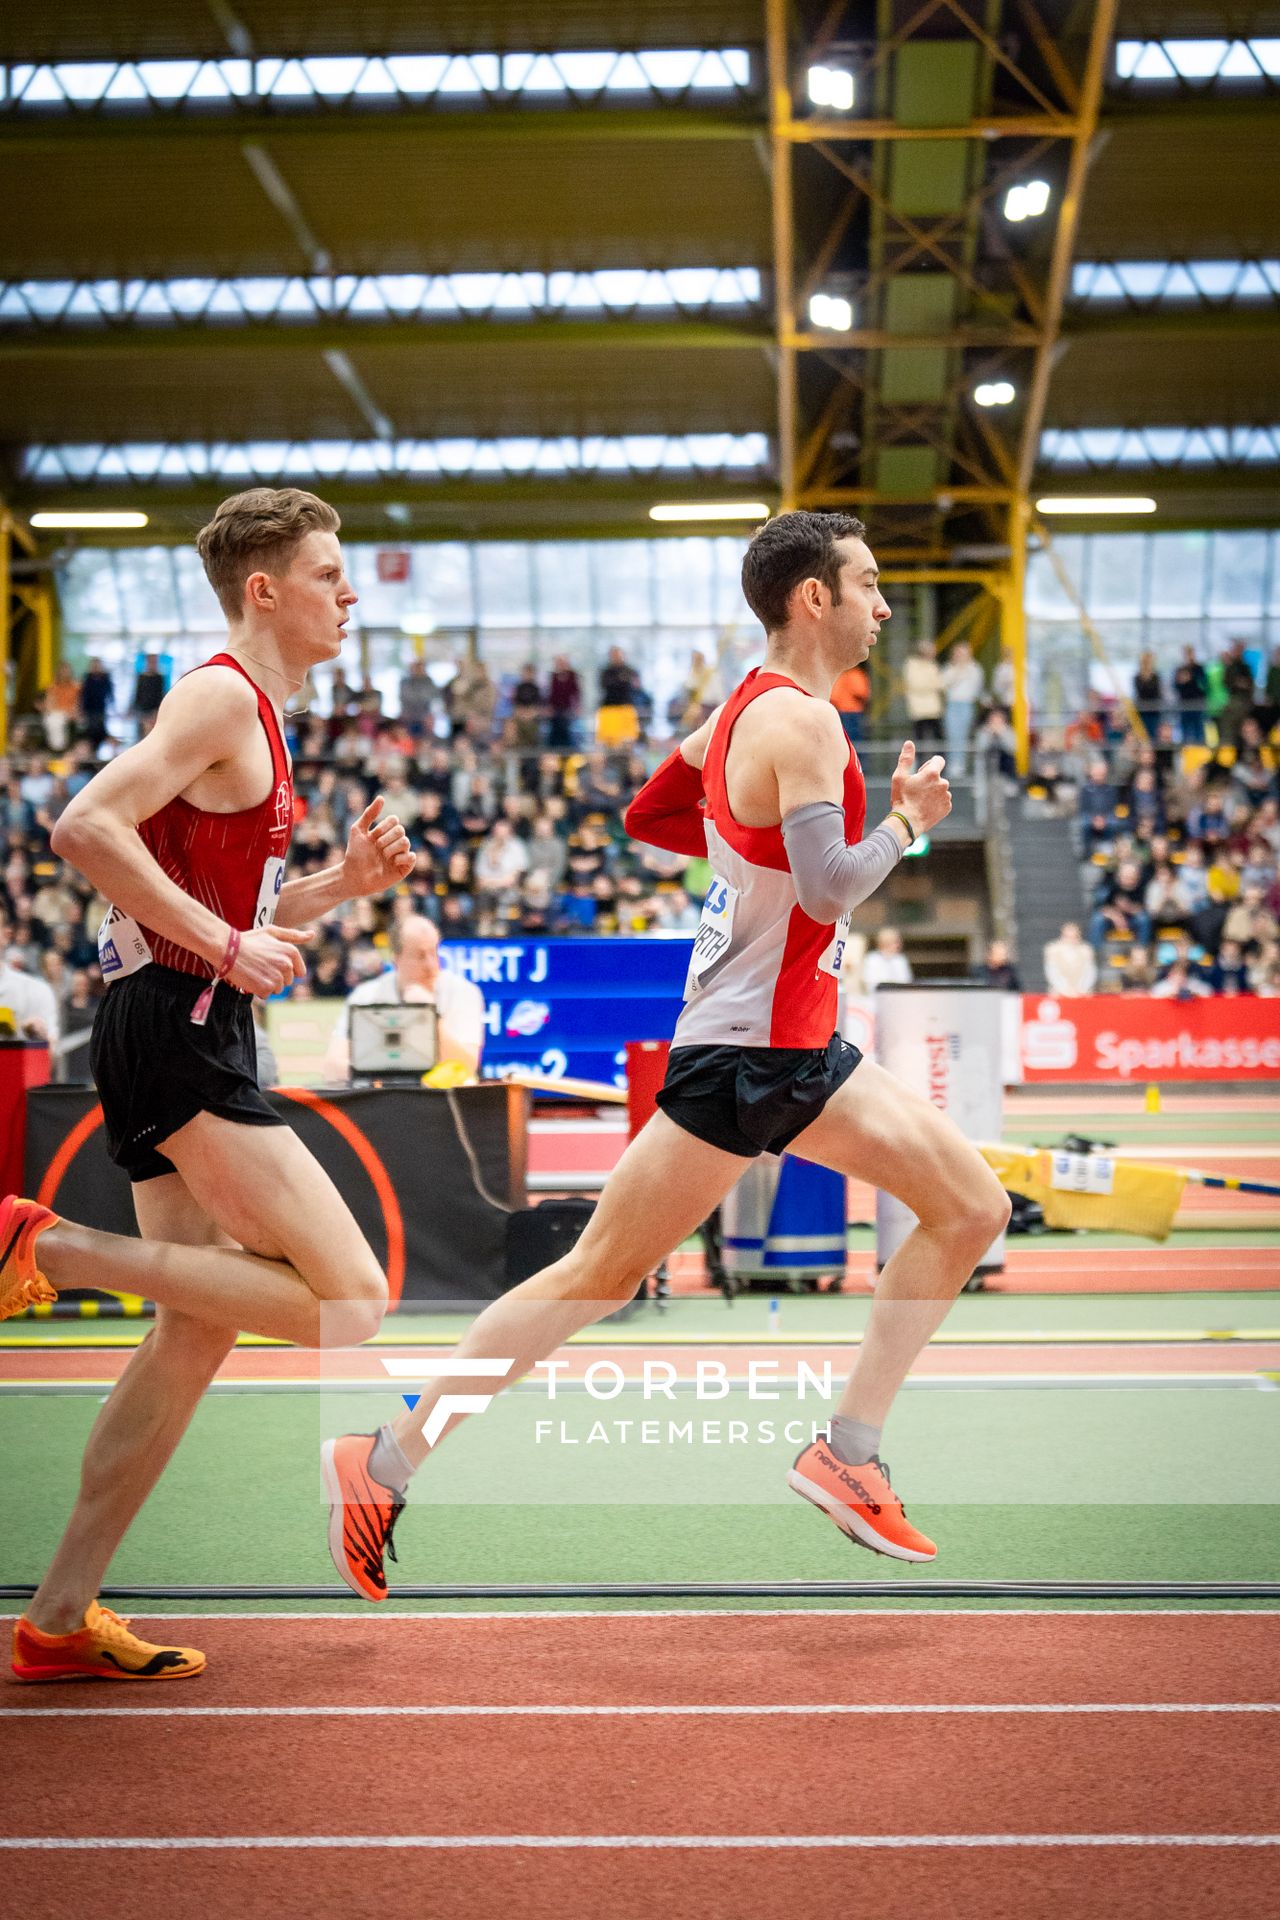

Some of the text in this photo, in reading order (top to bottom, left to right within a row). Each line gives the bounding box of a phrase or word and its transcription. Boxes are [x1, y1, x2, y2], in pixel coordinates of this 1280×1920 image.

[132, 937, 146, 955] 165
[529, 947, 548, 983] J
[1095, 1030, 1280, 1078] Sparkasse
[814, 1450, 882, 1515] new balance
